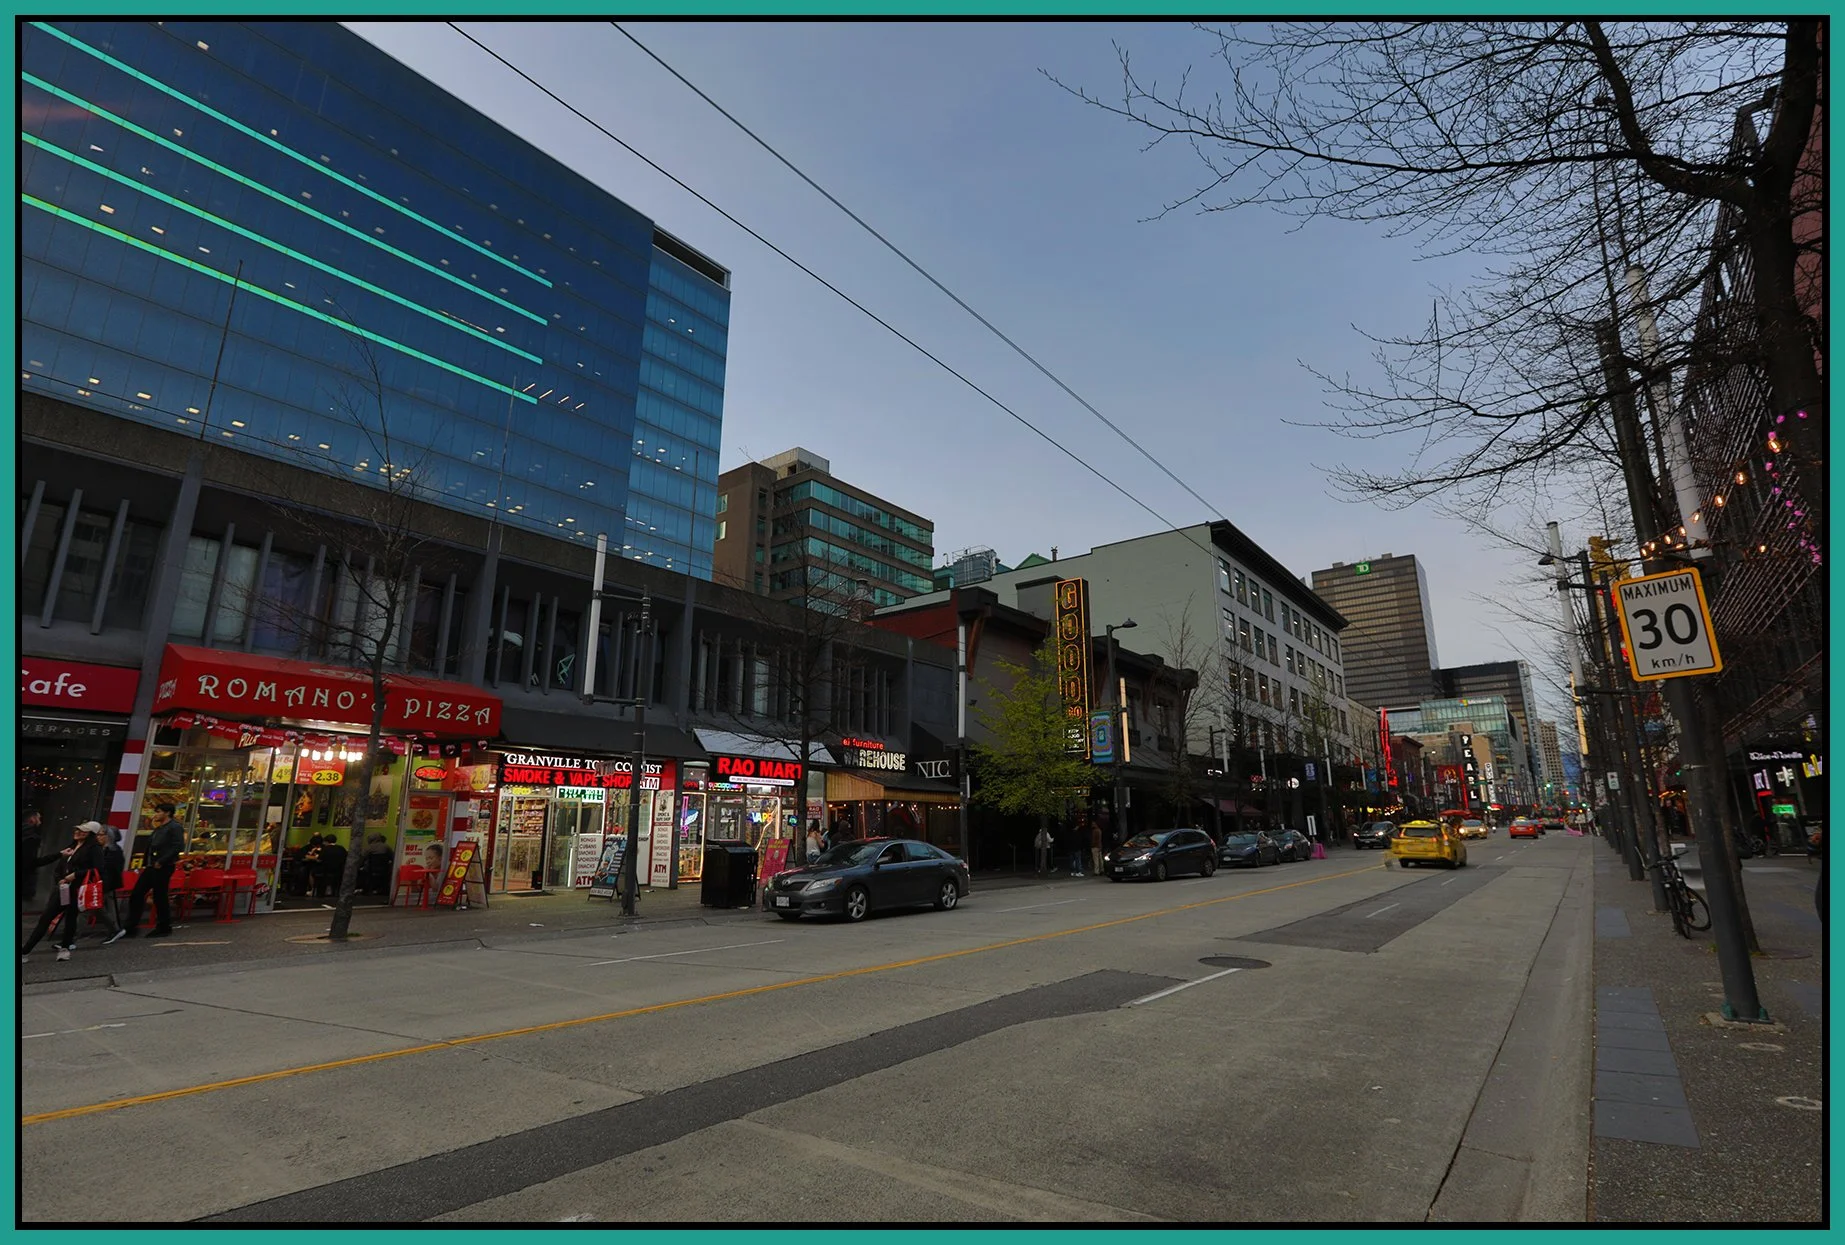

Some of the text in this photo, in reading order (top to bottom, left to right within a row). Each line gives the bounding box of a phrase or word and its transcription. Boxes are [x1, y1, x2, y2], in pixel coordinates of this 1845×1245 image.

[1356, 564, 1369, 573] TD
[1623, 577, 1691, 600] MAXIMUM
[1632, 603, 1698, 650] 30
[1651, 653, 1695, 669] km/h
[403, 698, 491, 725] PIZZA
[853, 738, 884, 750] furniture
[505, 752, 581, 769] GRANVILLE
[717, 757, 803, 779] RAO MART
[844, 749, 906, 771] WAREHOUSE
[315, 772, 340, 782] 2.38
[415, 766, 447, 779] OPEN
[504, 768, 632, 789] SMOKE & VAPE SHOP
[654, 864, 667, 873] ATM
